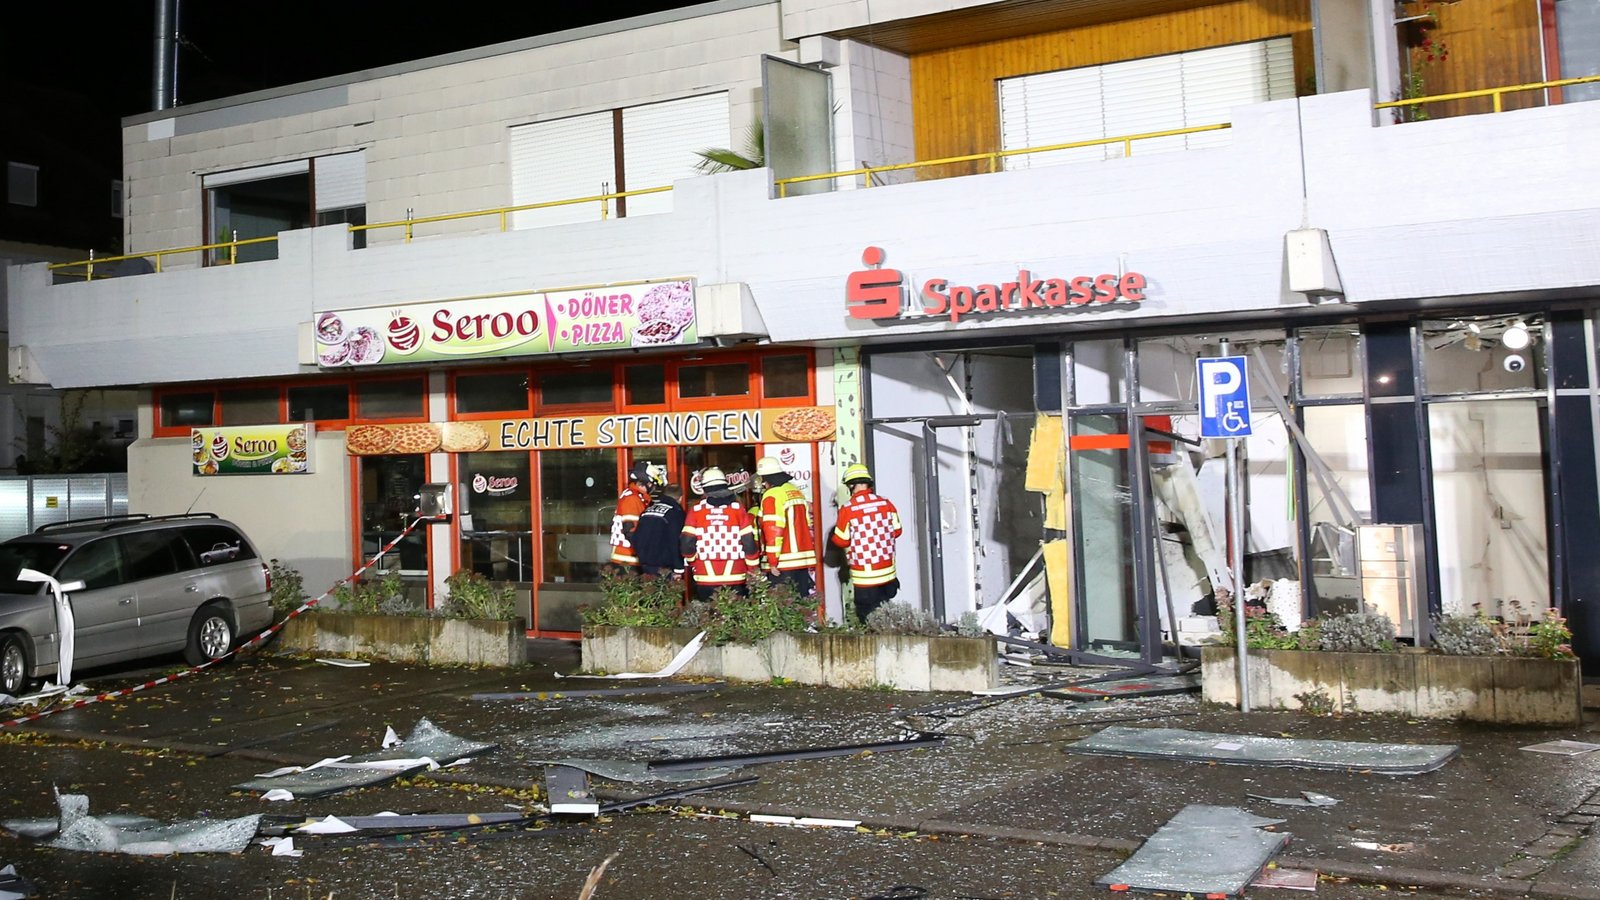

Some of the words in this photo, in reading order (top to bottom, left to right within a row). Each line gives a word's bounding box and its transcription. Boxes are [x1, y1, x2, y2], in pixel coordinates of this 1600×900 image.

[568, 293, 633, 318] DÖNER
[923, 269, 1146, 323] Sparkasse
[430, 309, 539, 342] Seroo
[572, 321, 625, 345] PIZZA
[1202, 361, 1241, 418] P
[500, 419, 585, 448] ECHTE
[598, 411, 760, 445] STEINOFEN
[234, 436, 277, 454] Seroo
[489, 476, 518, 488] Seroo
[726, 471, 749, 485] roo
[784, 470, 811, 481] roo
